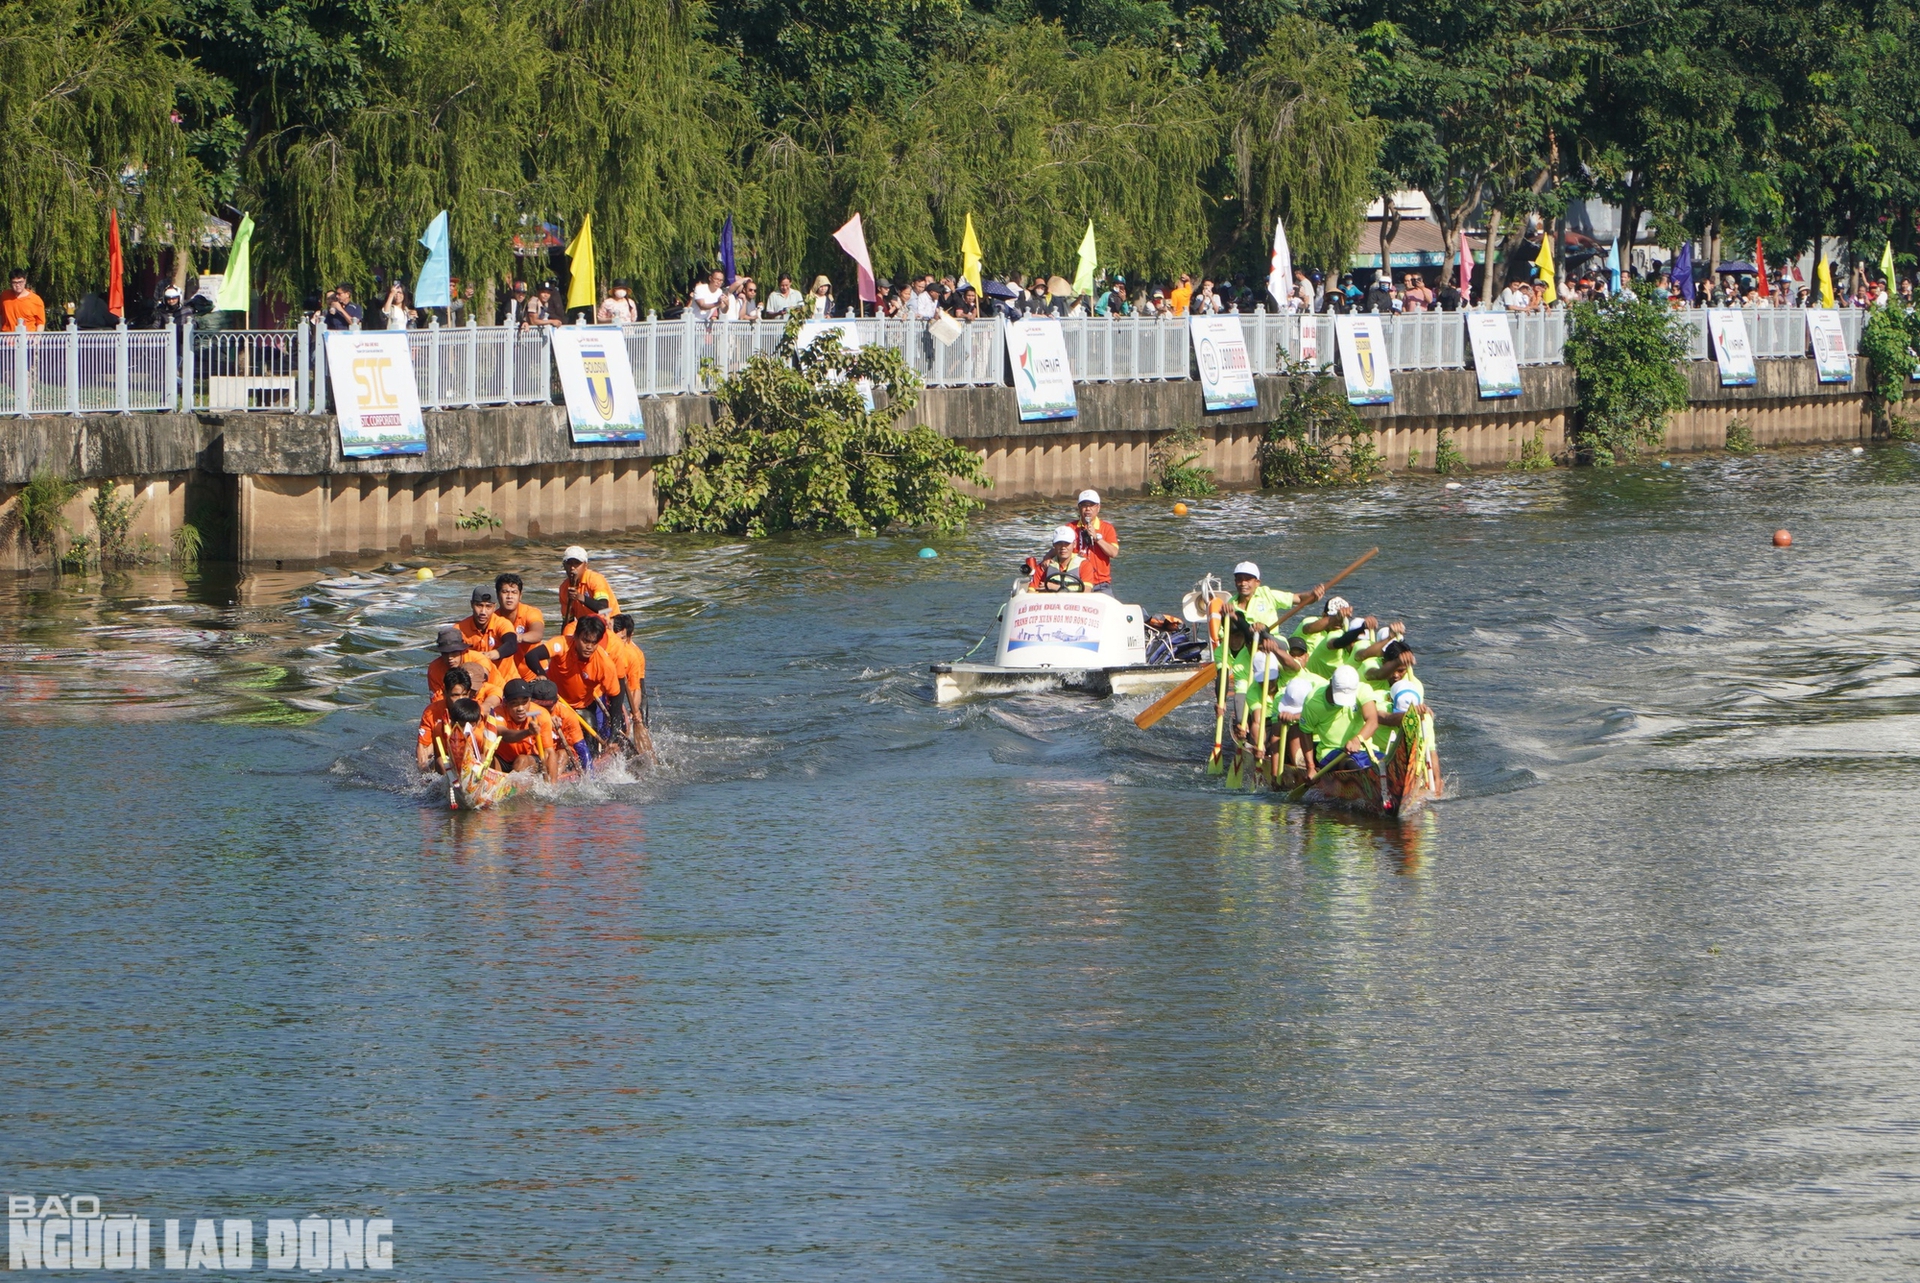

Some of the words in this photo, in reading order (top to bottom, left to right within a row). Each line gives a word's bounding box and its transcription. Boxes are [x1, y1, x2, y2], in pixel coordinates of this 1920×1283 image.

[352, 357, 398, 405] STC
[360, 415, 370, 427] STC
[370, 414, 401, 426] CORPORATION
